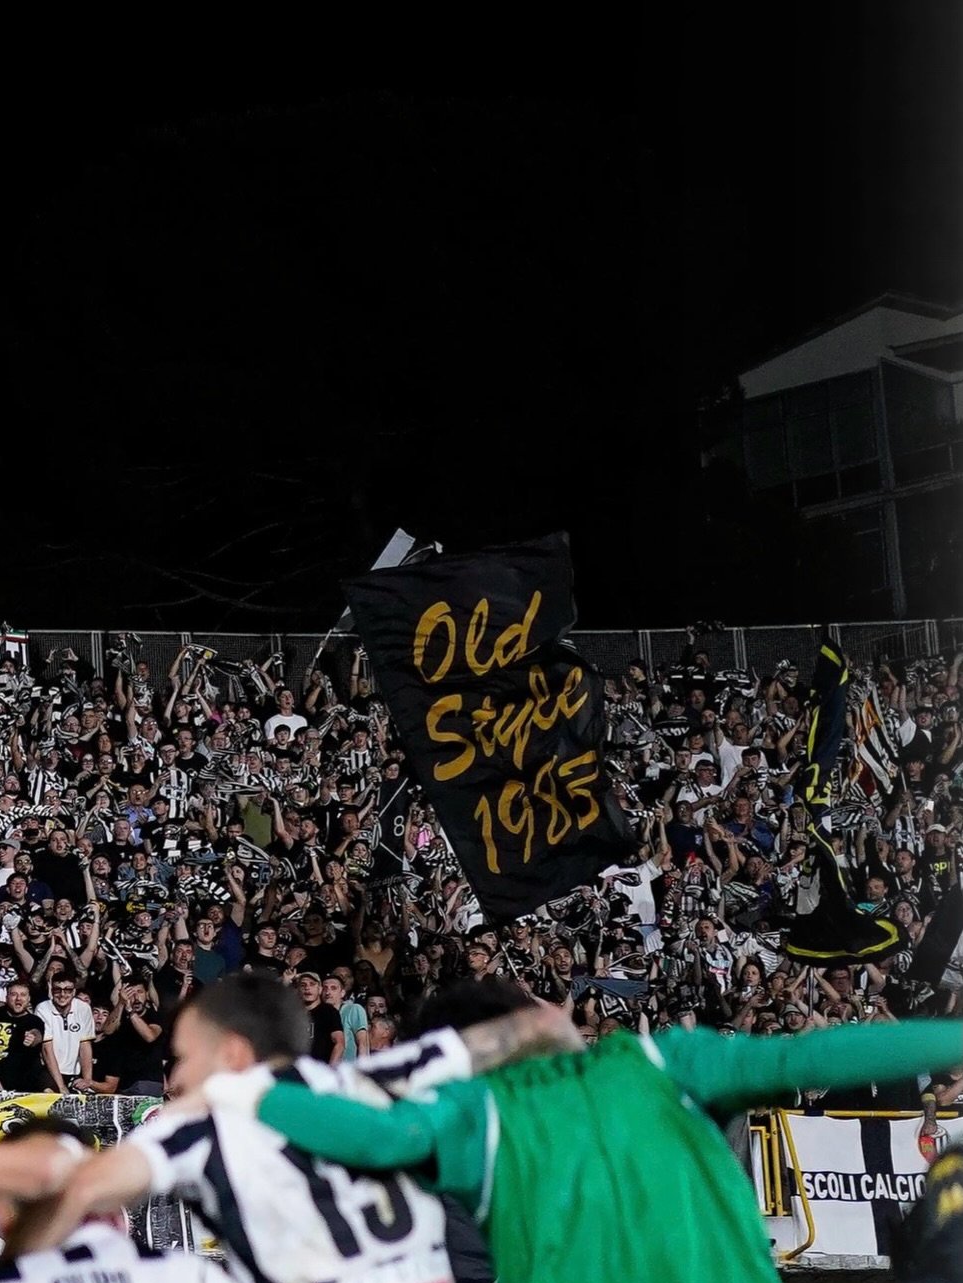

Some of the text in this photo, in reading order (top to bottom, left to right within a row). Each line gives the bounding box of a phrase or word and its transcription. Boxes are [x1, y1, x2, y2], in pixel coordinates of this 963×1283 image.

[413, 590, 542, 684] Old
[426, 664, 588, 782] Style
[474, 750, 600, 875] 1985
[799, 1172, 927, 1202] SCOLI CALCIO
